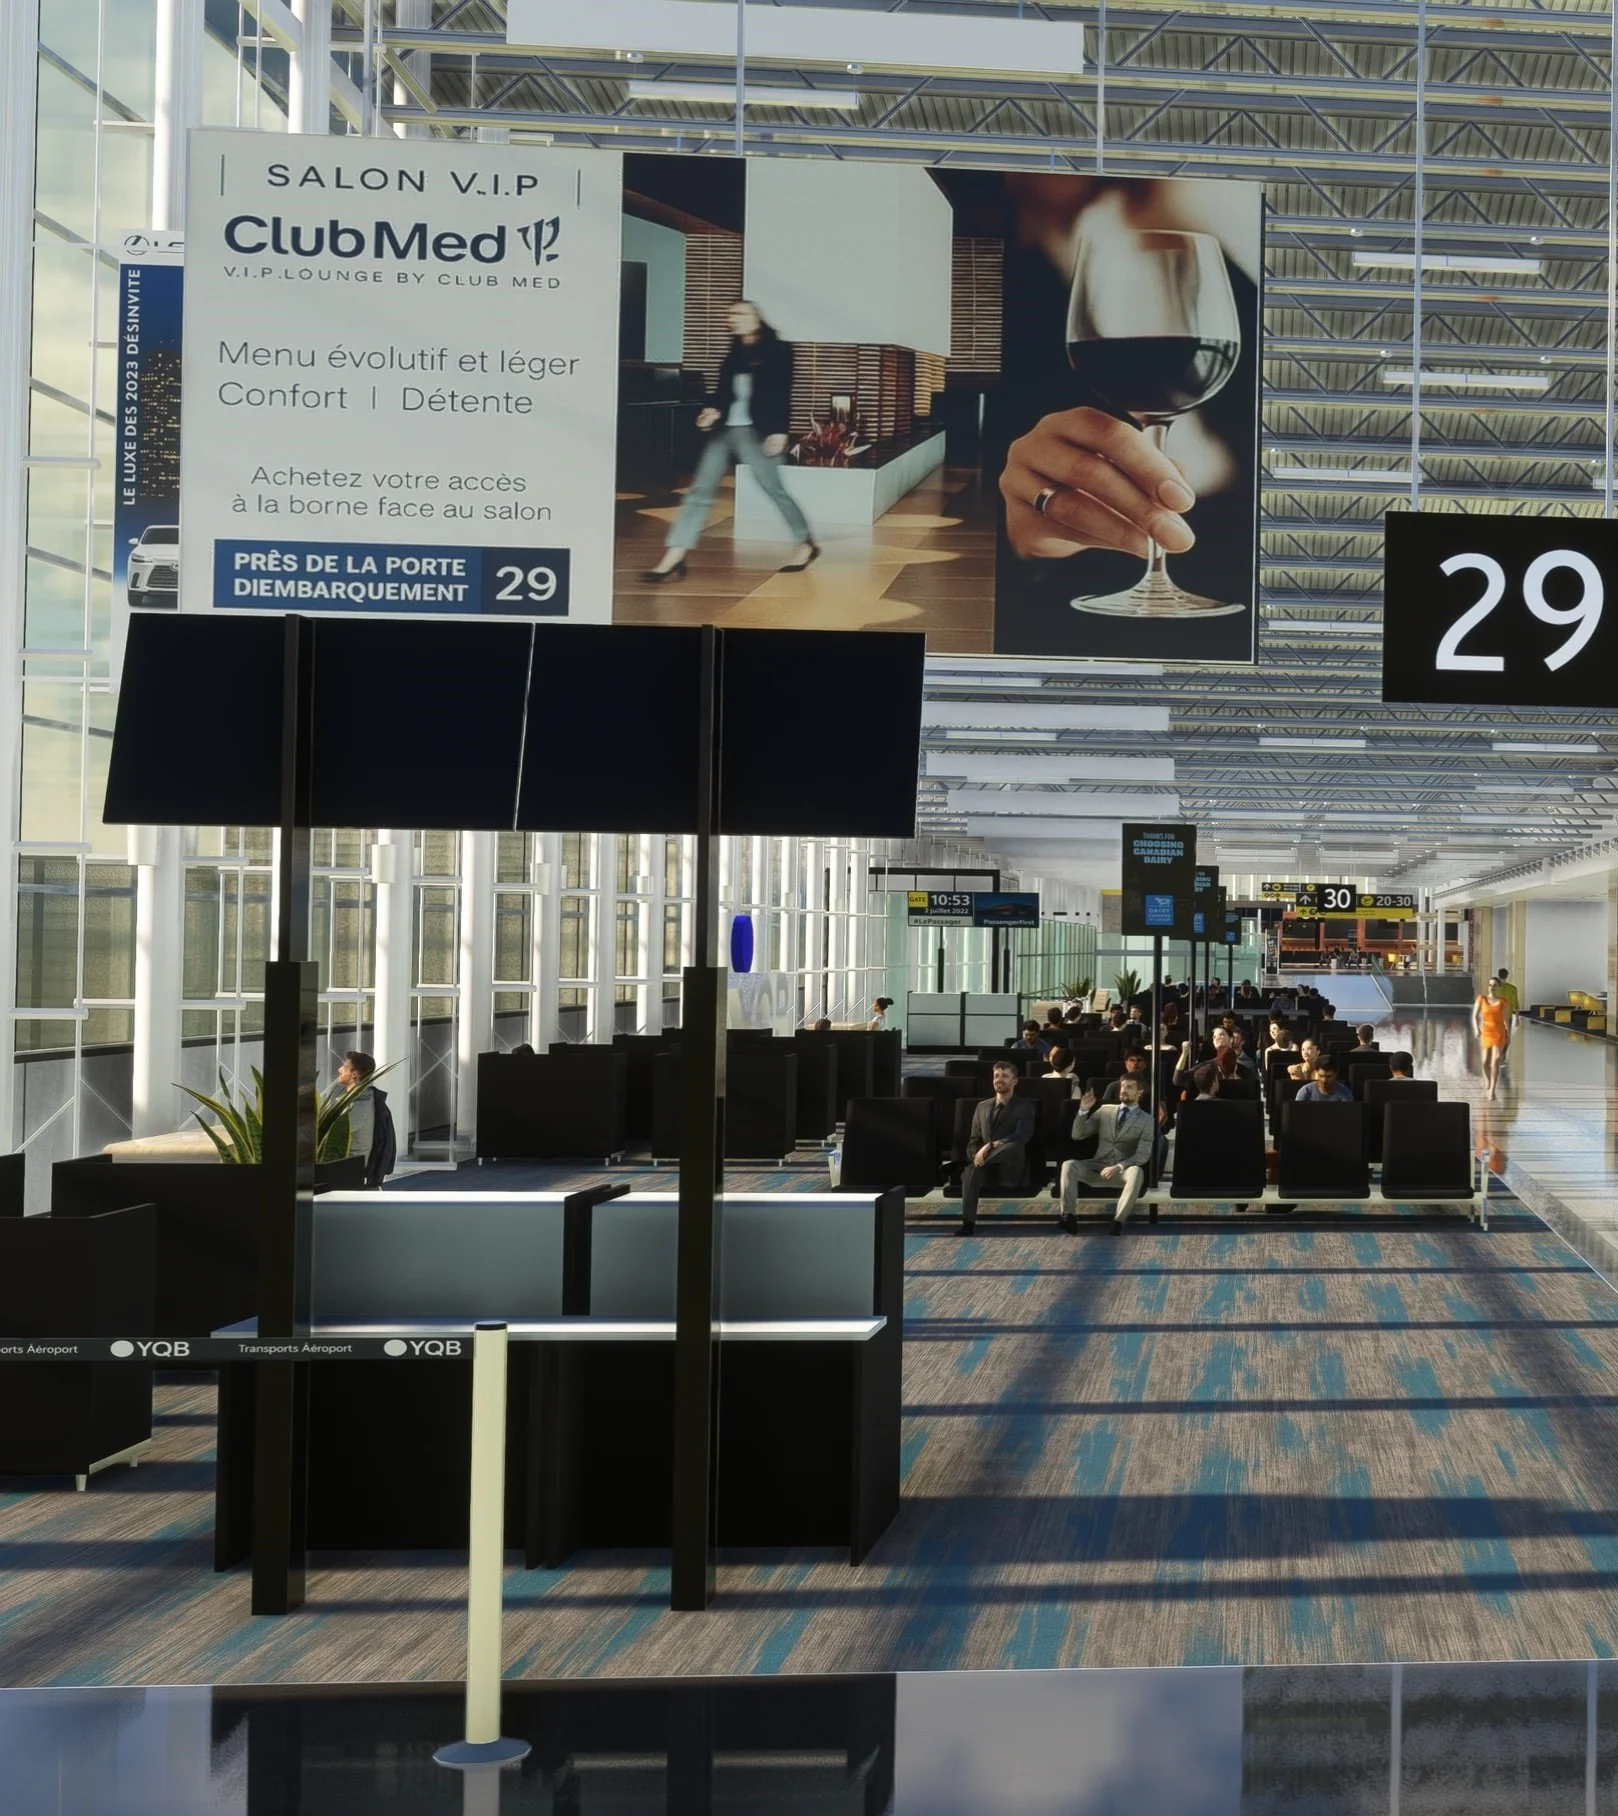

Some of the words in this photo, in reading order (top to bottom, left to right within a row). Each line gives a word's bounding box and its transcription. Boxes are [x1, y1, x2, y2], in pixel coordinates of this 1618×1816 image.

[267, 163, 425, 193] SALON
[396, 272, 425, 284] BY
[437, 273, 499, 287] CLUB
[512, 276, 561, 289] MED
[219, 340, 316, 368] Menu
[327, 343, 448, 373] évolutif
[458, 350, 489, 374] et
[500, 349, 580, 382] léger
[126, 360, 139, 401] 2023
[218, 381, 348, 409] Confort
[402, 386, 533, 414] Détente
[125, 405, 137, 436] DES
[124, 441, 137, 483] LUXE
[250, 465, 363, 488] Achetez
[372, 470, 440, 491] votre
[448, 472, 527, 493] accès
[123, 488, 136, 506] LE
[231, 493, 248, 514] à
[257, 493, 280, 515] la
[289, 494, 369, 517] borne
[378, 496, 435, 519] face
[442, 503, 474, 520] au
[483, 501, 552, 522] salon
[305, 554, 339, 573] DE
[346, 555, 378, 574] LA
[385, 556, 467, 577] PORTE
[495, 566, 557, 601] 29
[1435, 549, 1604, 672] 29
[1133, 840, 1184, 848] CHOOSING
[1133, 848, 1184, 856] CANADIAN
[1144, 856, 1173, 864] DAIRY
[931, 894, 970, 906] 10:53
[1324, 888, 1351, 909] 30
[1376, 895, 1411, 907] 20-30
[0, 1346, 24, 1354] orts
[136, 1341, 190, 1358] YQB
[238, 1344, 299, 1356] Transports
[409, 1340, 462, 1357] YQB
